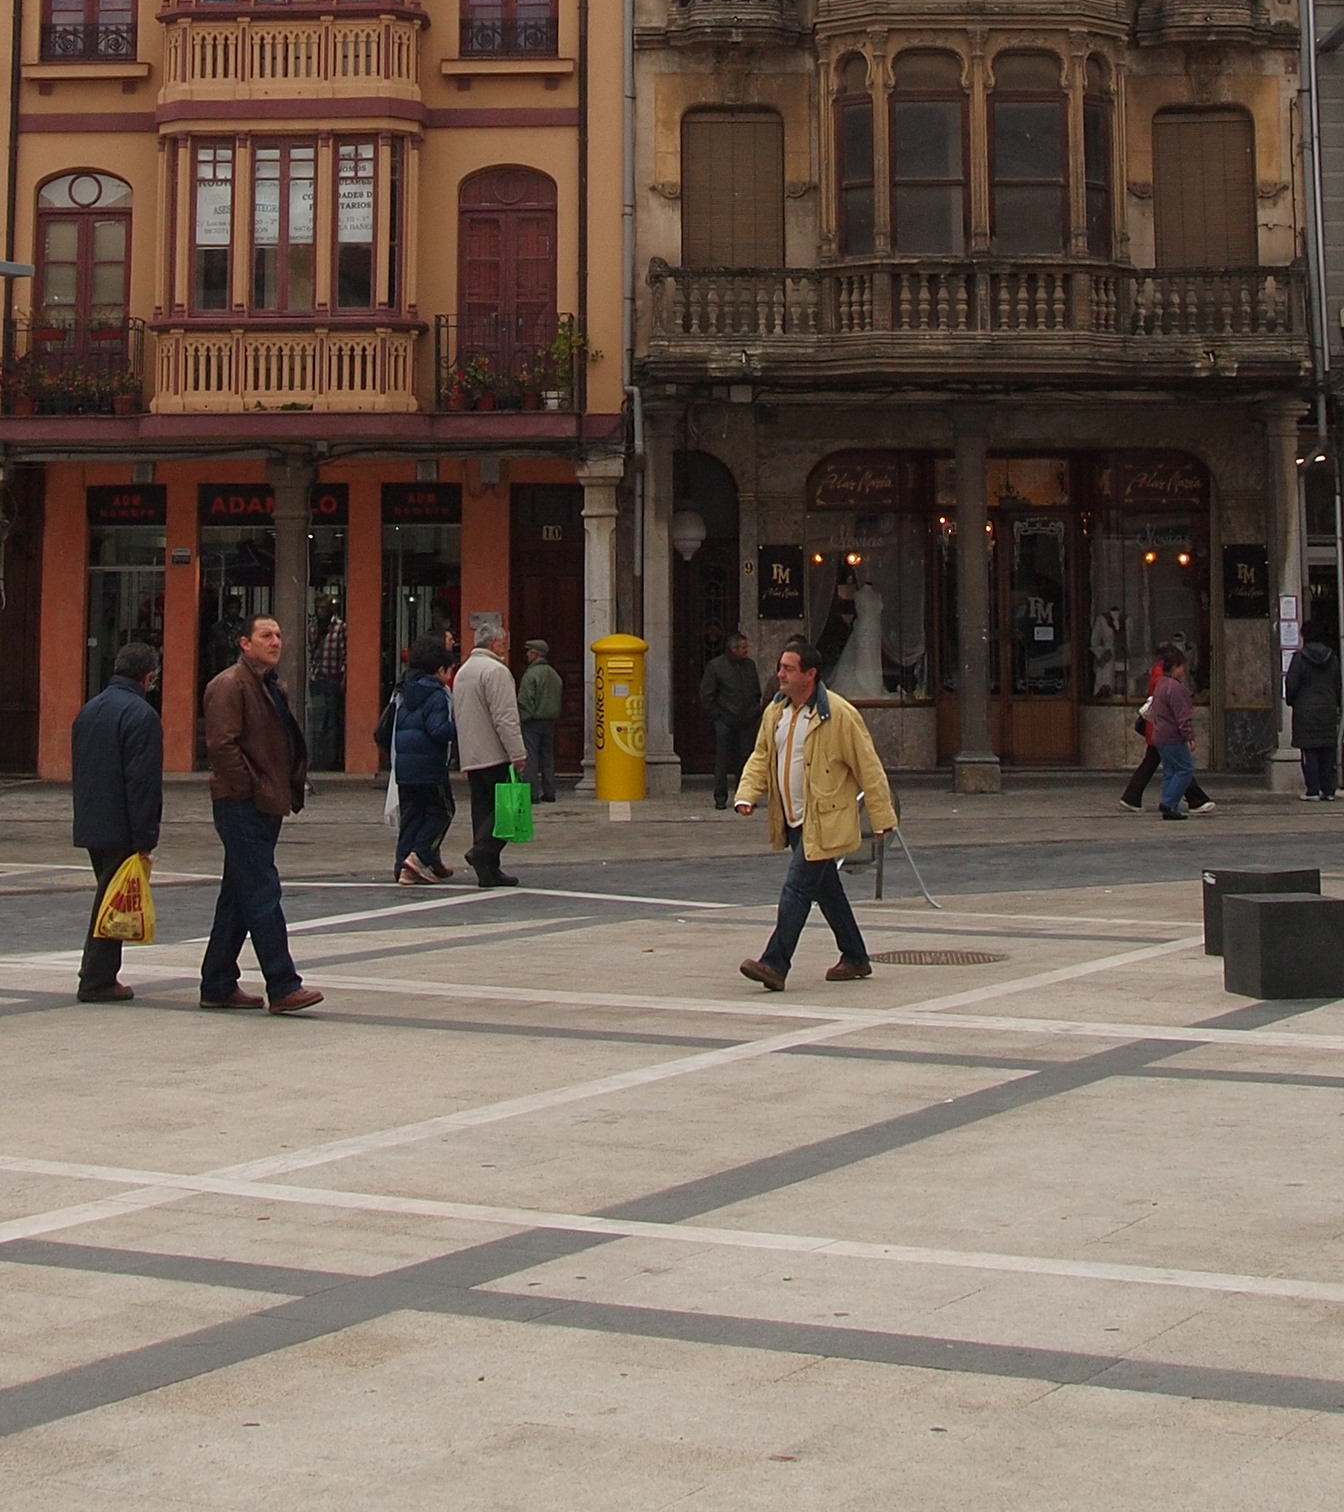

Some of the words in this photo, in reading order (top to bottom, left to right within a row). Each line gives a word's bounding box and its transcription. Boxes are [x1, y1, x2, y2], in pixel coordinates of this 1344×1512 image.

[544, 525, 561, 539] 10
[744, 562, 754, 575] 9
[595, 667, 605, 750] CORREOS
